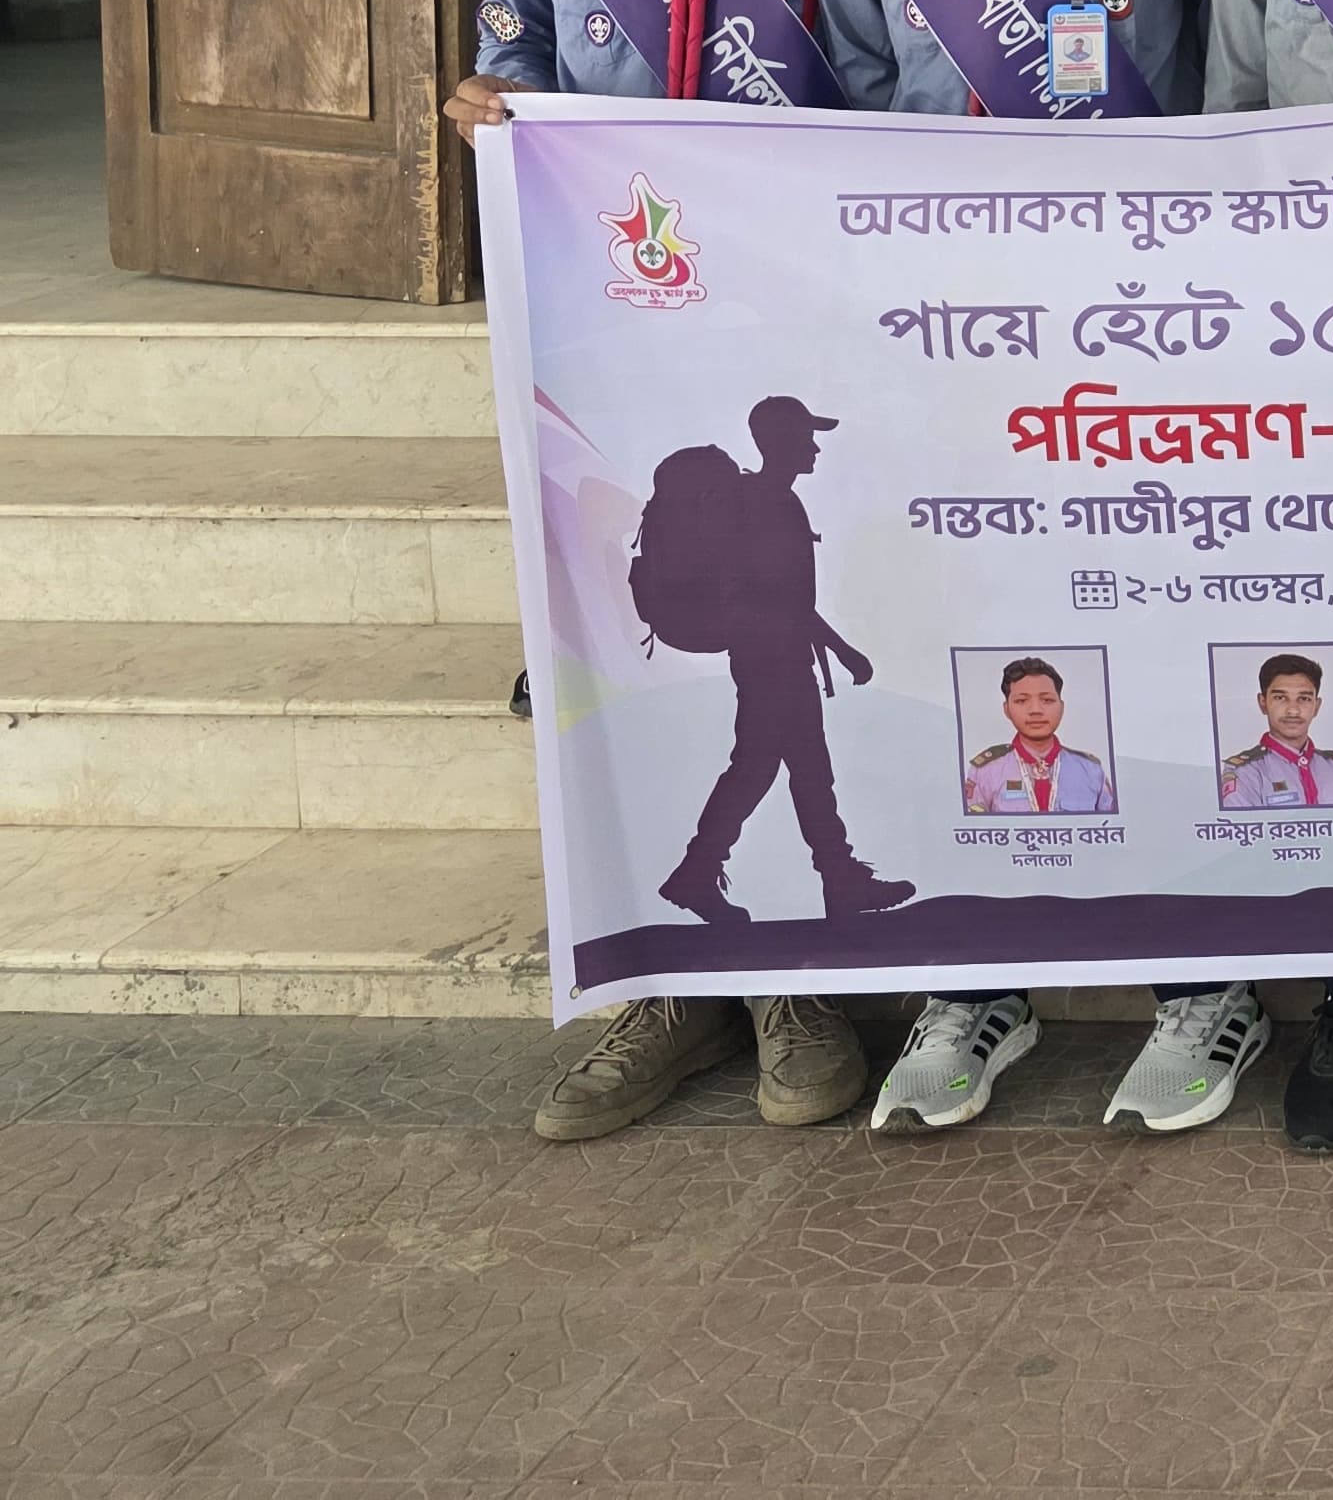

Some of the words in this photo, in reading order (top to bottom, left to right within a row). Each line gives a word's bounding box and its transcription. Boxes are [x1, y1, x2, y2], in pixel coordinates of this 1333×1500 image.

[837, 192, 1106, 236] অবলোকন
[1118, 190, 1214, 251] মুক্ত
[878, 299, 1049, 361] পায়ে
[1072, 281, 1246, 362] হেঁটে
[908, 495, 1048, 539] গন্তব্য:
[1060, 481, 1253, 551] গাজীপুর
[1125, 573, 1193, 604] ২-৬
[953, 824, 1008, 849] অনন্ত
[1013, 822, 1074, 853] কুমার
[1077, 820, 1126, 848] বর্মন
[1194, 816, 1266, 846] নাঈমুর
[1011, 850, 1074, 869] দলনেতা
[1272, 845, 1323, 864] সদস্য
